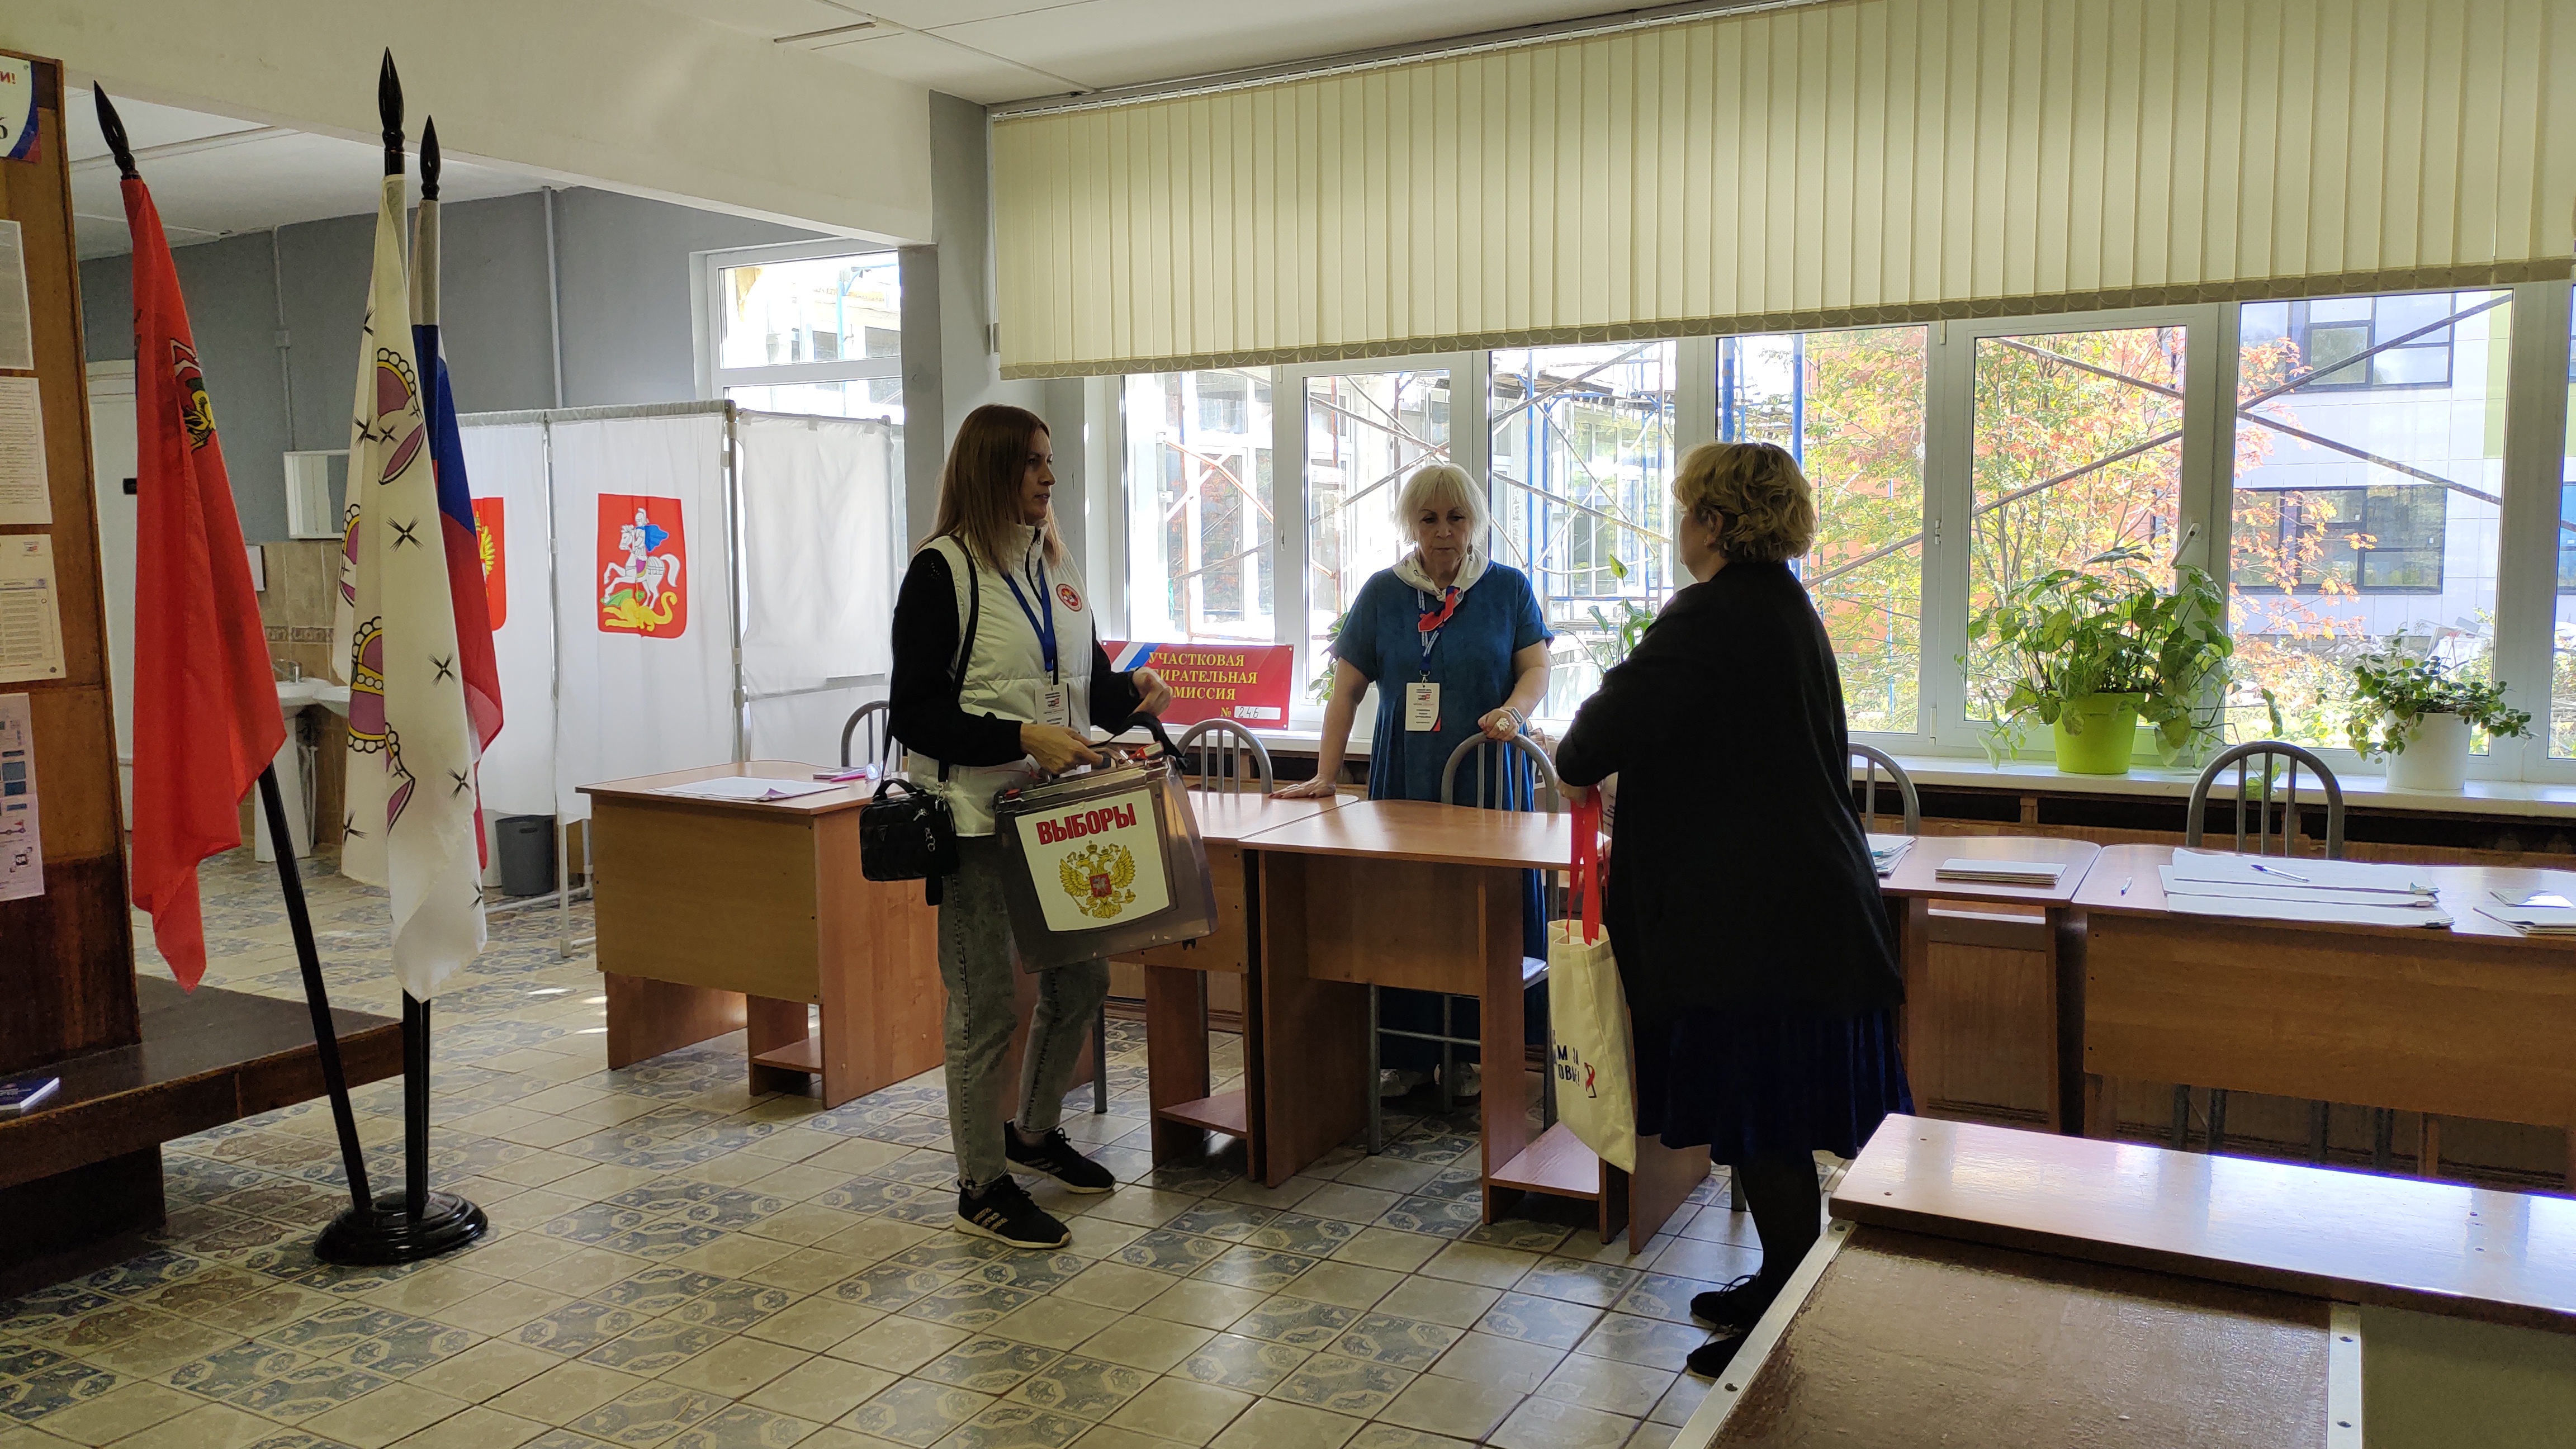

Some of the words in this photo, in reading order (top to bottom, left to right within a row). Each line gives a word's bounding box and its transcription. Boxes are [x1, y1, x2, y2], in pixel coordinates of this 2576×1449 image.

[1148, 651, 1245, 667] УЧАСТКОВАЯ
[1154, 669, 1258, 684] ИРАТЕЛЬНАЯ
[1168, 686, 1236, 700] МИССИЯ
[1220, 707, 1232, 718] №
[1238, 706, 1259, 718] 246
[1036, 803, 1137, 845] ВЫБОРЫ
